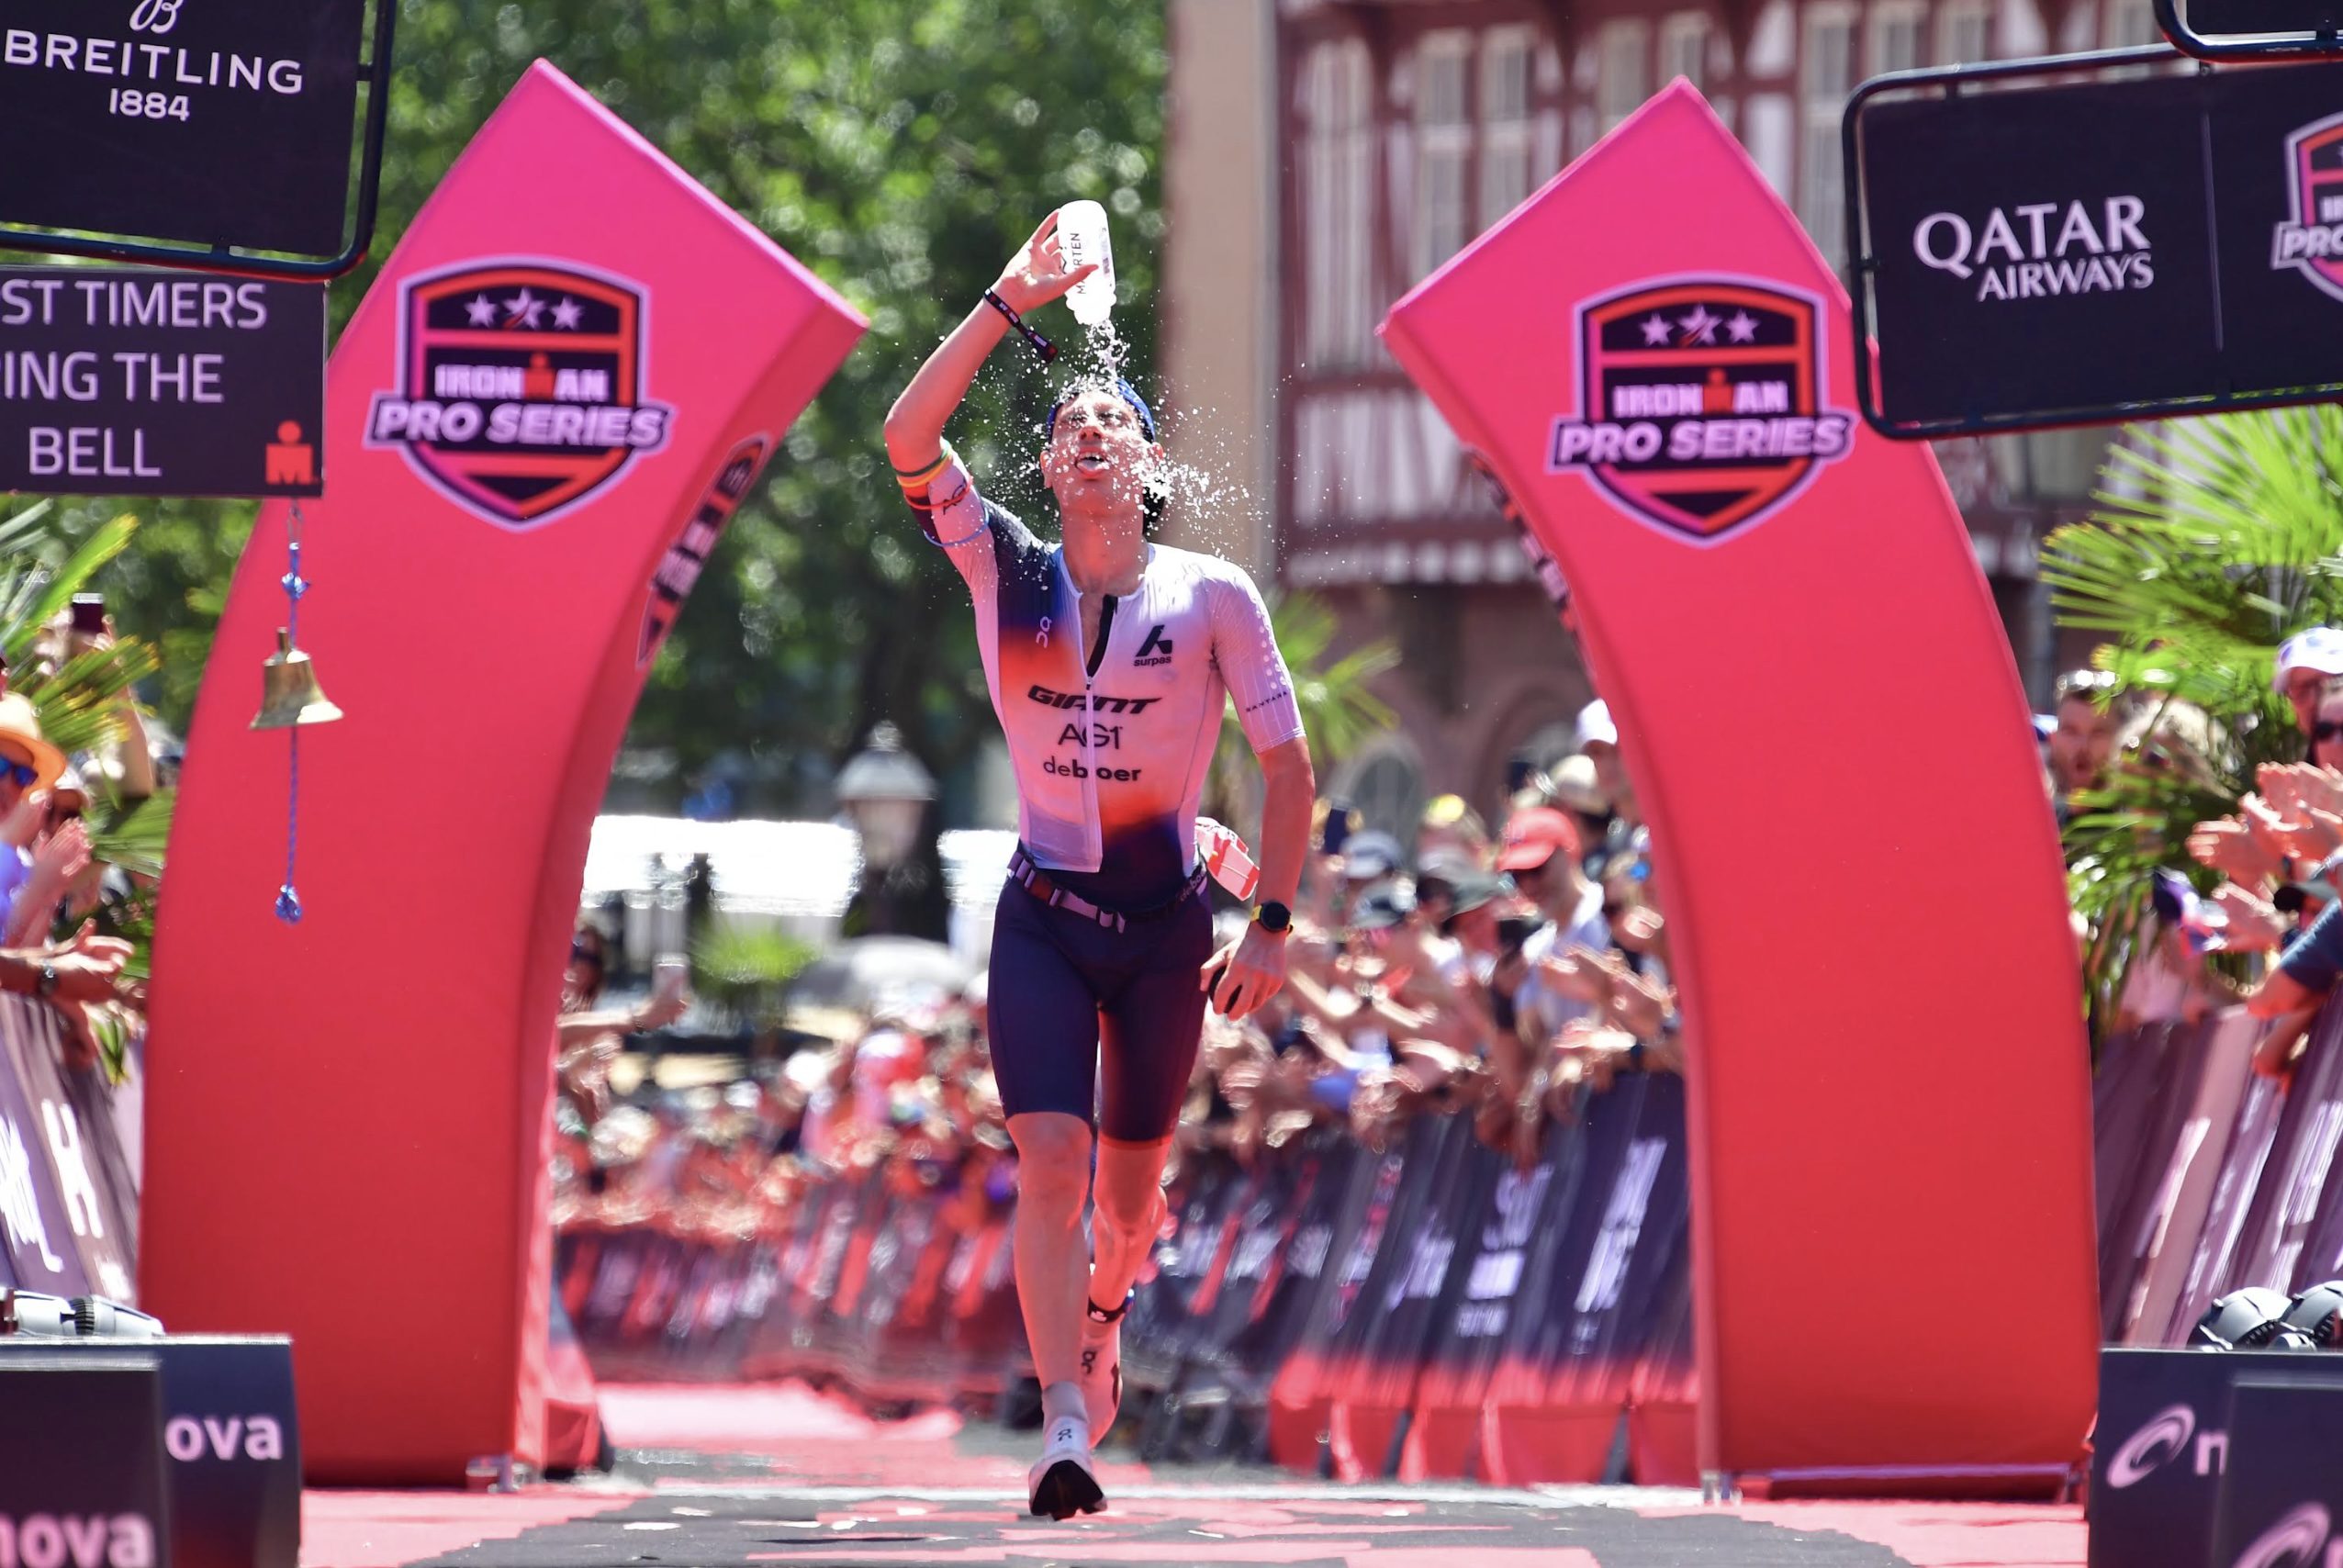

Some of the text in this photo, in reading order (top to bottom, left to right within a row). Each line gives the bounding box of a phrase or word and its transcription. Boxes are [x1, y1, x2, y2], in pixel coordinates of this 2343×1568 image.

[5, 29, 303, 94] BREITLING
[109, 88, 190, 121] 1884
[1912, 195, 2152, 279] QATAR
[1070, 232, 1087, 295] MRTEN
[1977, 252, 2155, 301] AIRWAYS
[75, 281, 267, 329] TIMERS
[113, 353, 223, 403] THE
[374, 401, 667, 448] PRO SERIES
[1560, 417, 1851, 464] PRO SERIES
[28, 427, 162, 477] BELL
[1134, 655, 1172, 666] surpas
[1027, 684, 1162, 714] GIANT
[1058, 722, 1120, 750] AG1
[1043, 756, 1141, 781] deboer
